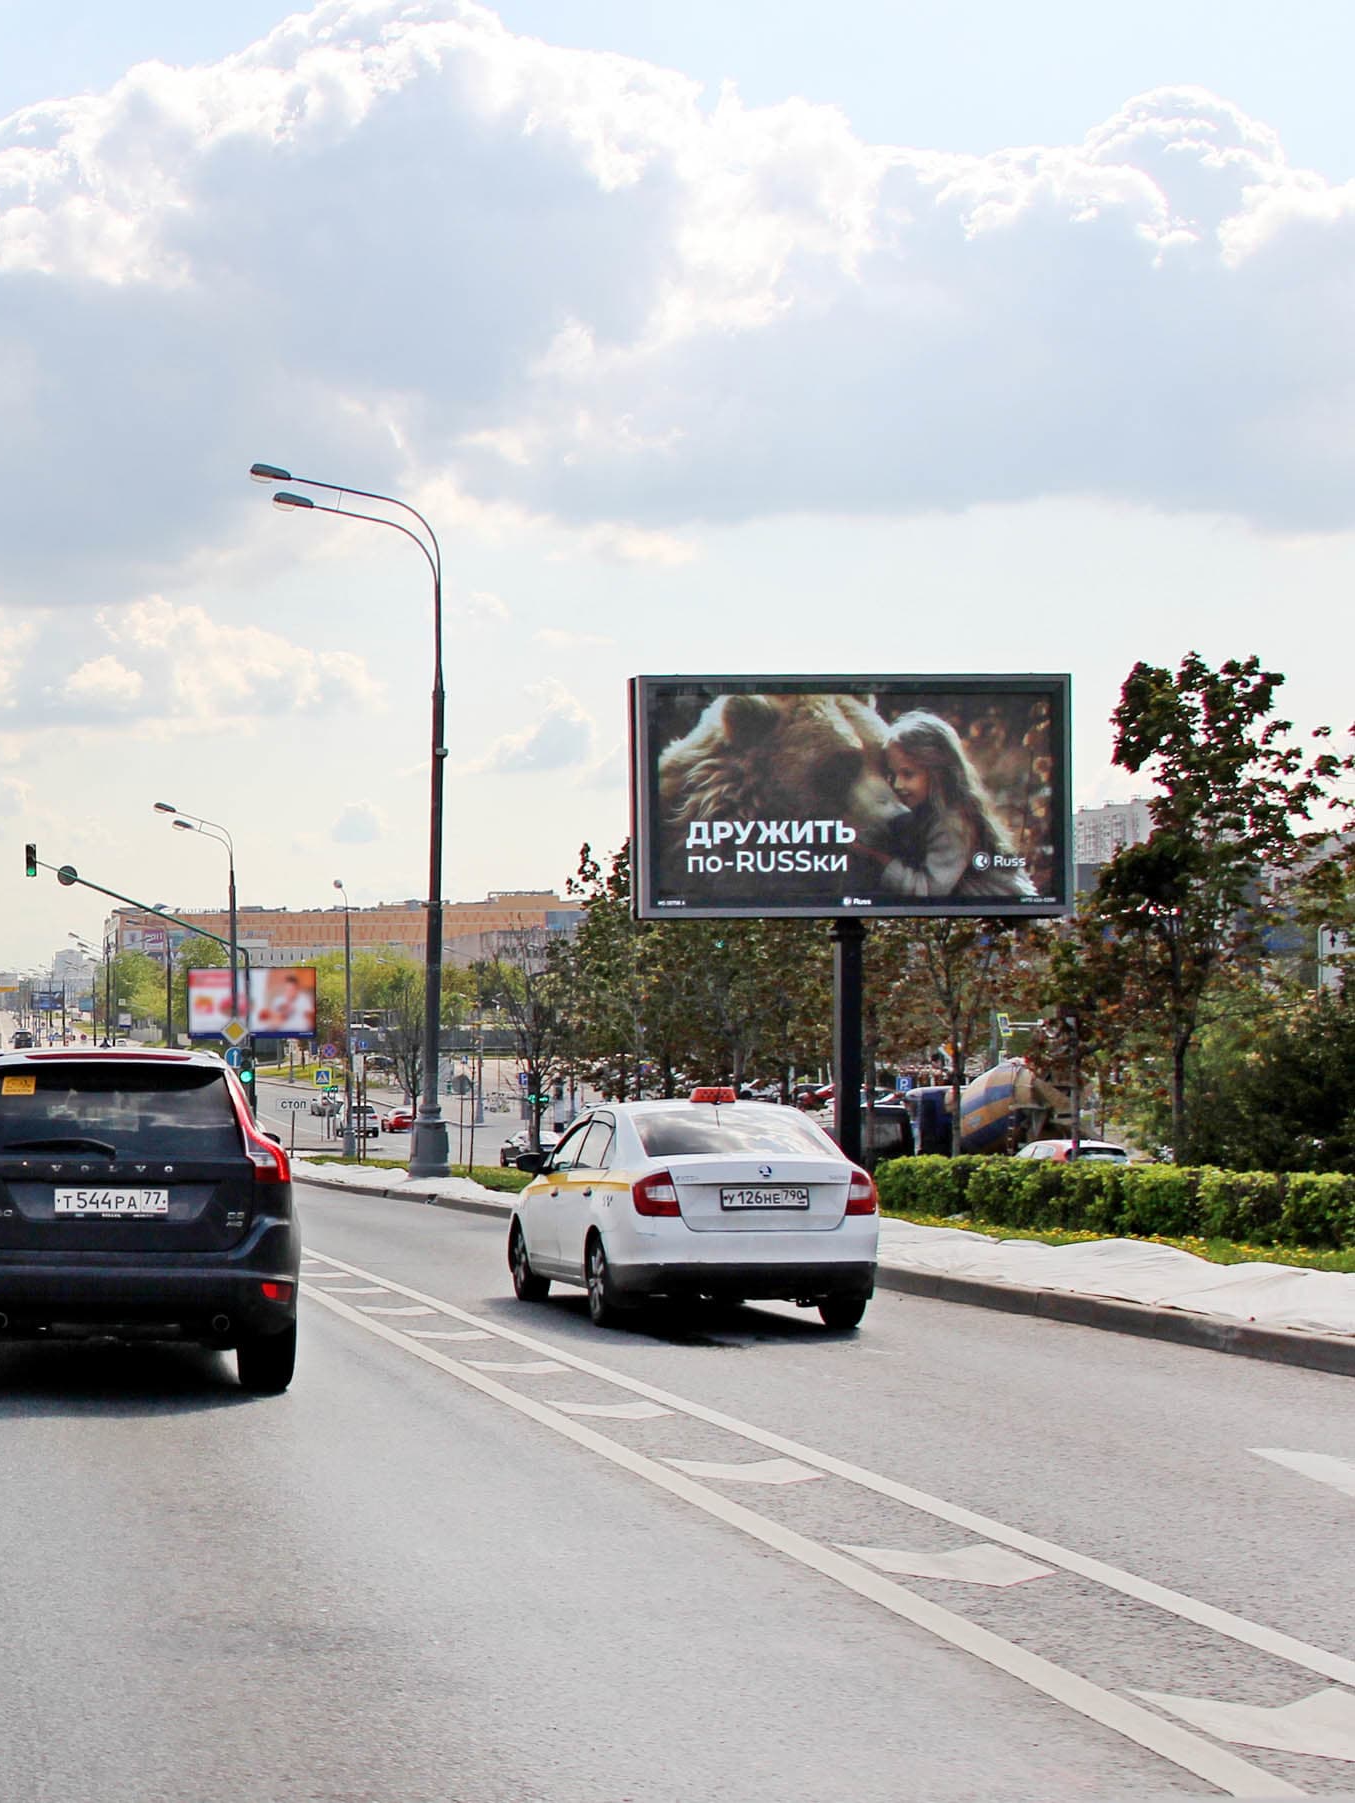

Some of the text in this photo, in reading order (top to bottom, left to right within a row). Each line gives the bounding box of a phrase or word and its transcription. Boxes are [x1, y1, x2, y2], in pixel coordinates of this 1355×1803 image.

[685, 820, 857, 849] ДРУЖИТЬ
[687, 850, 848, 873] по-RUSSки
[993, 855, 1026, 867] Russ
[280, 1100, 307, 1109] СТОП
[50, 1164, 174, 1174] VOLVO
